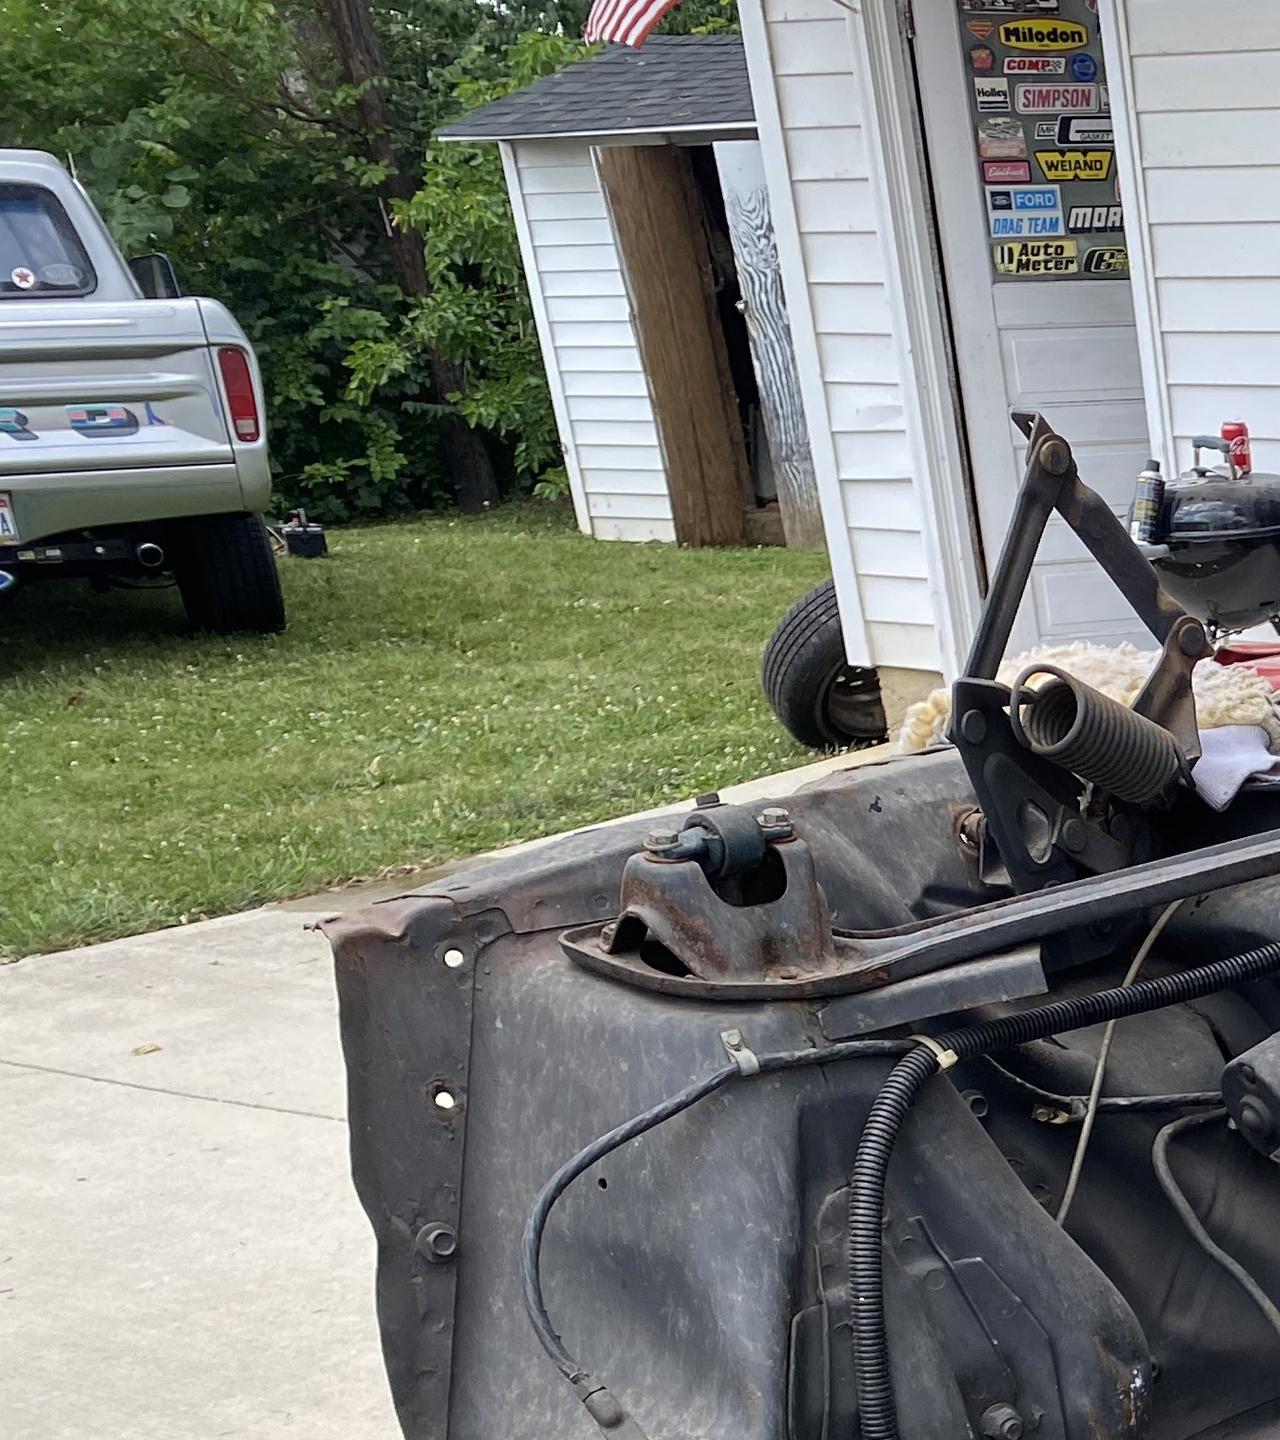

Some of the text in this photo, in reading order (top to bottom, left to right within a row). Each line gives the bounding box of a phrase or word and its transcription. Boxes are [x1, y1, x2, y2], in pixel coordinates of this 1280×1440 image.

[1003, 27, 1084, 43] Milodon
[1007, 59, 1051, 71] COMP
[977, 87, 1008, 99] Holley
[1022, 89, 1092, 108] SIMPSON
[1080, 132, 1111, 141] GASKET
[1045, 159, 1104, 172] WEIAND
[1015, 193, 1055, 207] FORD
[992, 216, 1060, 235] DRAG TEAM
[1018, 242, 1065, 258] Auto
[1016, 257, 1076, 273] Meter
